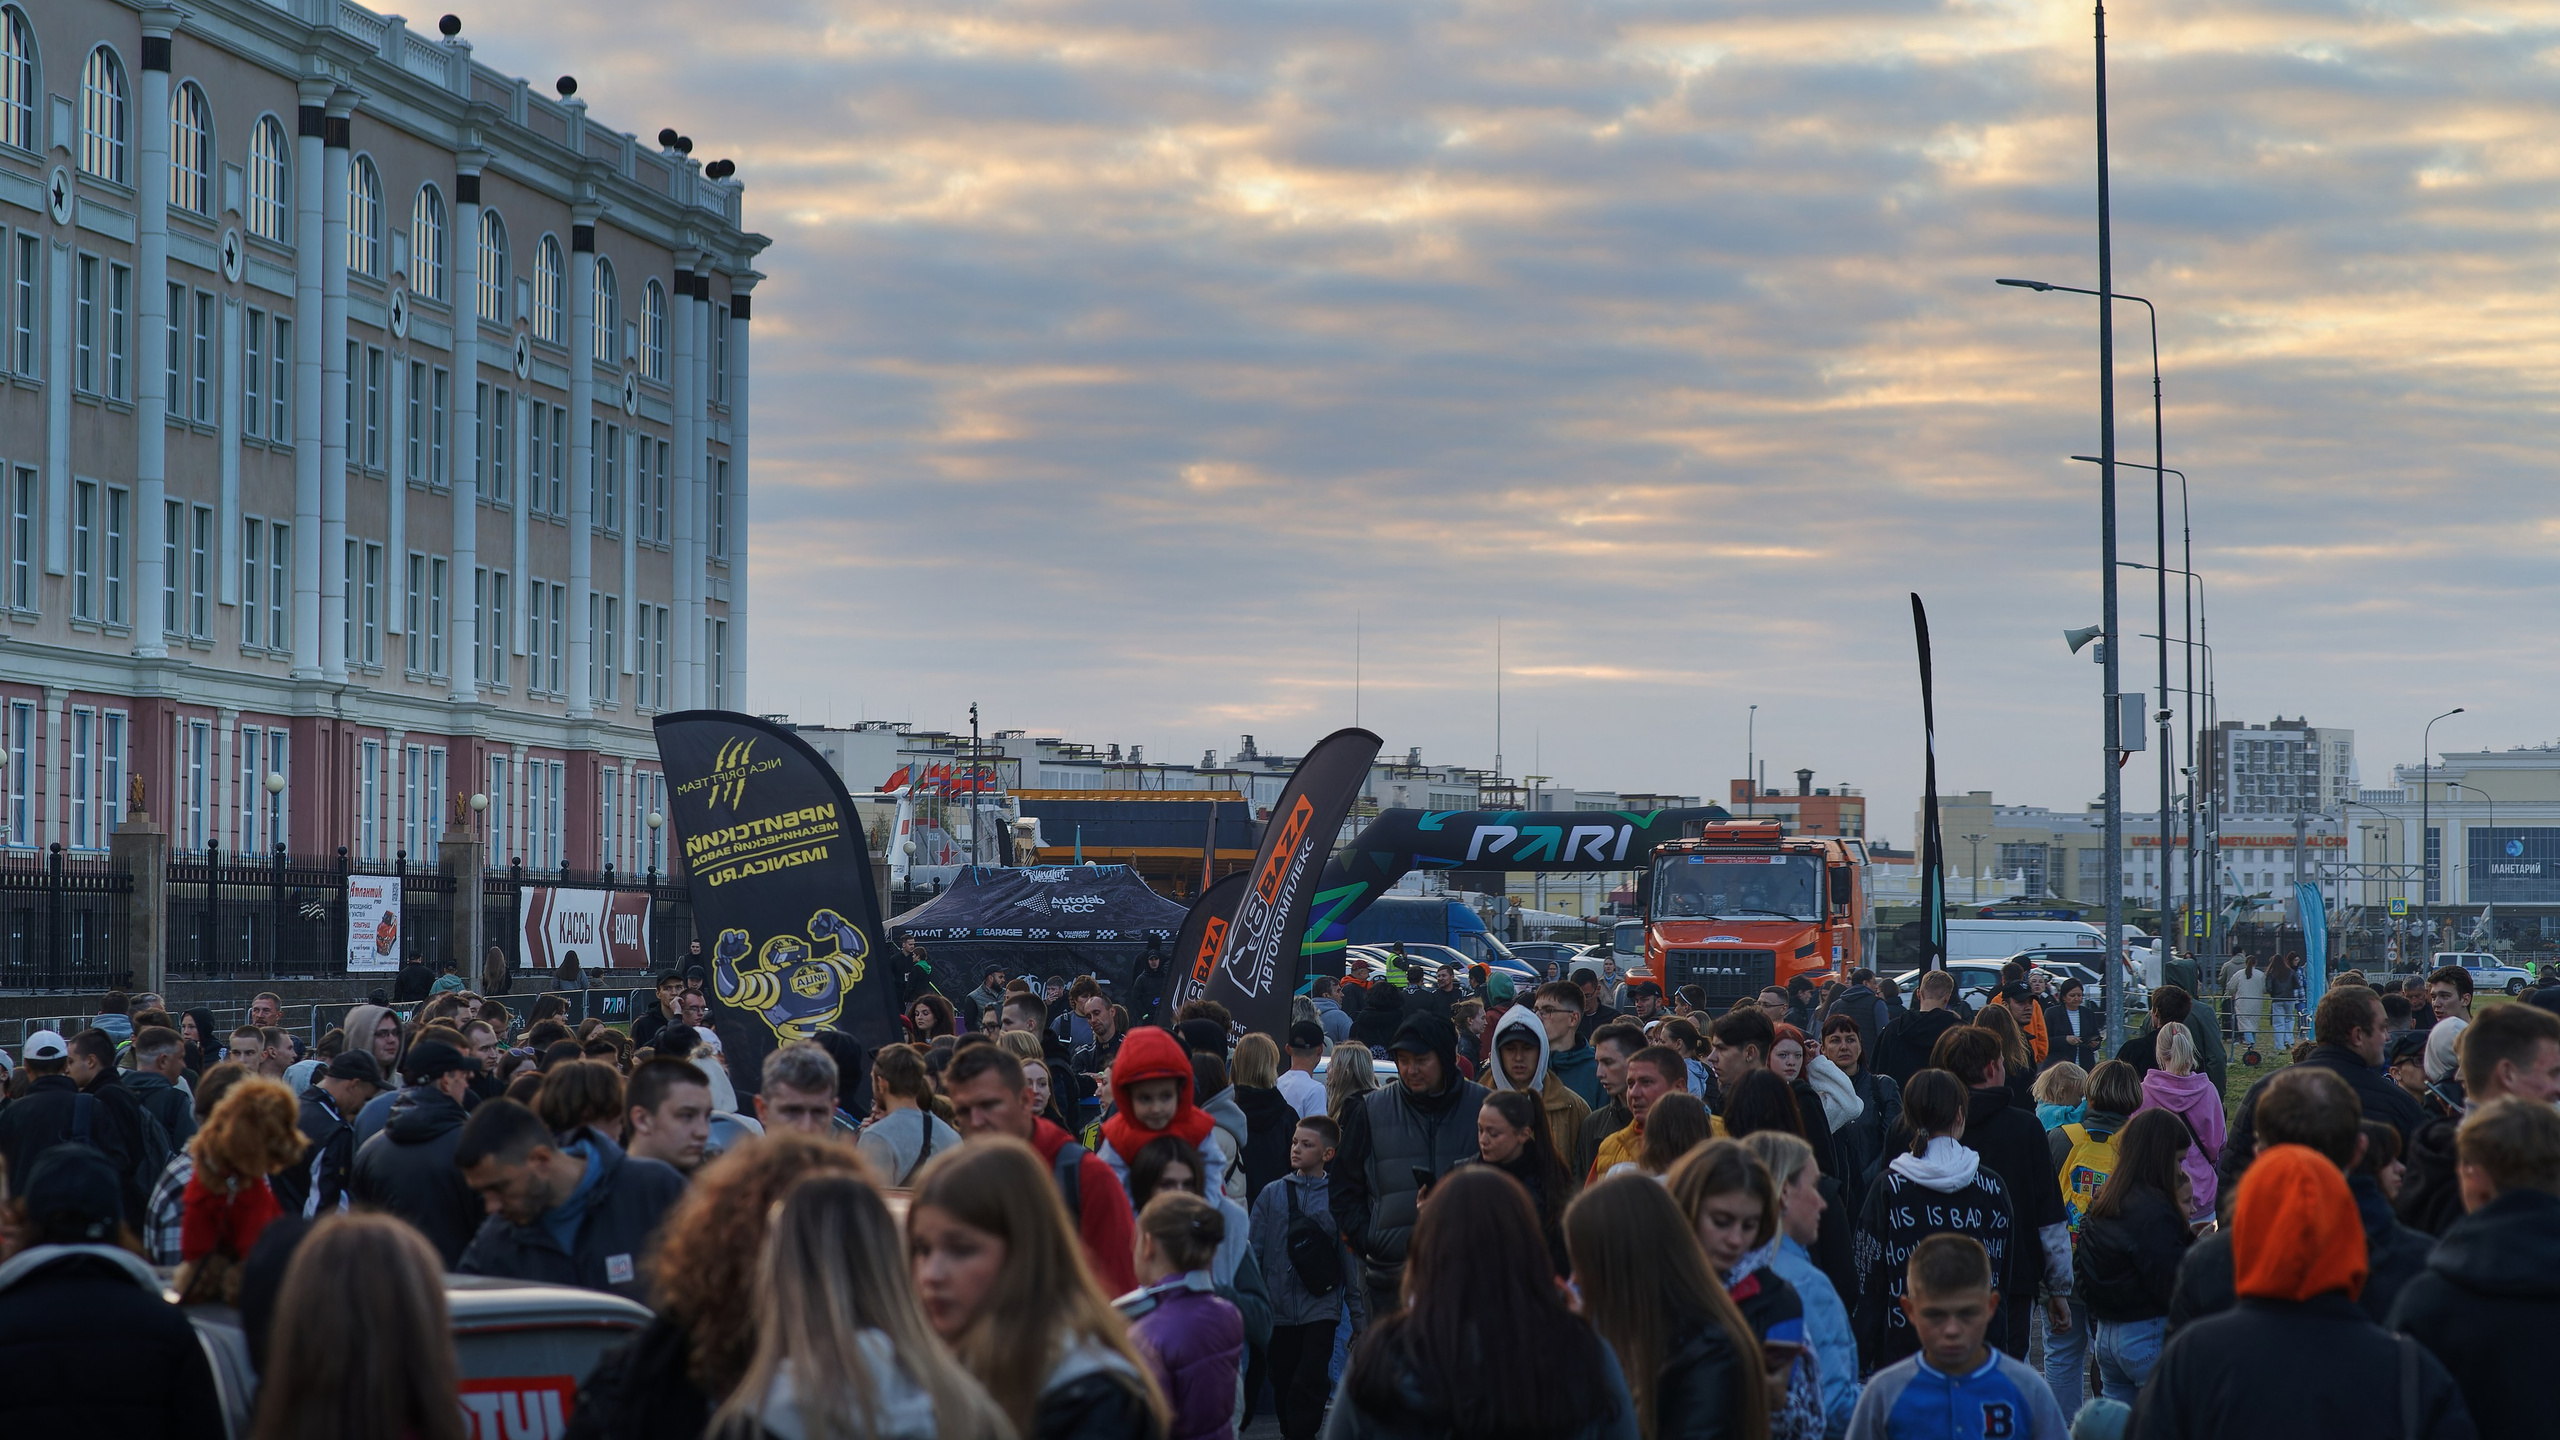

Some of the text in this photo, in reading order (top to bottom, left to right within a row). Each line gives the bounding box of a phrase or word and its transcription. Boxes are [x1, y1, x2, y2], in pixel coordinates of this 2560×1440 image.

[1466, 824, 1633, 862] PARI
[1051, 895, 1106, 905] Autolab
[1062, 904, 1095, 914] RCC
[559, 911, 594, 945] КАССЫ
[1258, 836, 1315, 994] АВТОКОМПЛЕКС
[615, 913, 638, 950] ВХОД
[1692, 967, 1747, 976] URAL
[602, 997, 626, 1014] PARI
[1926, 1204, 1943, 1226] IS
[1950, 1207, 1982, 1229] BAD
[1981, 1401, 2014, 1440] B
